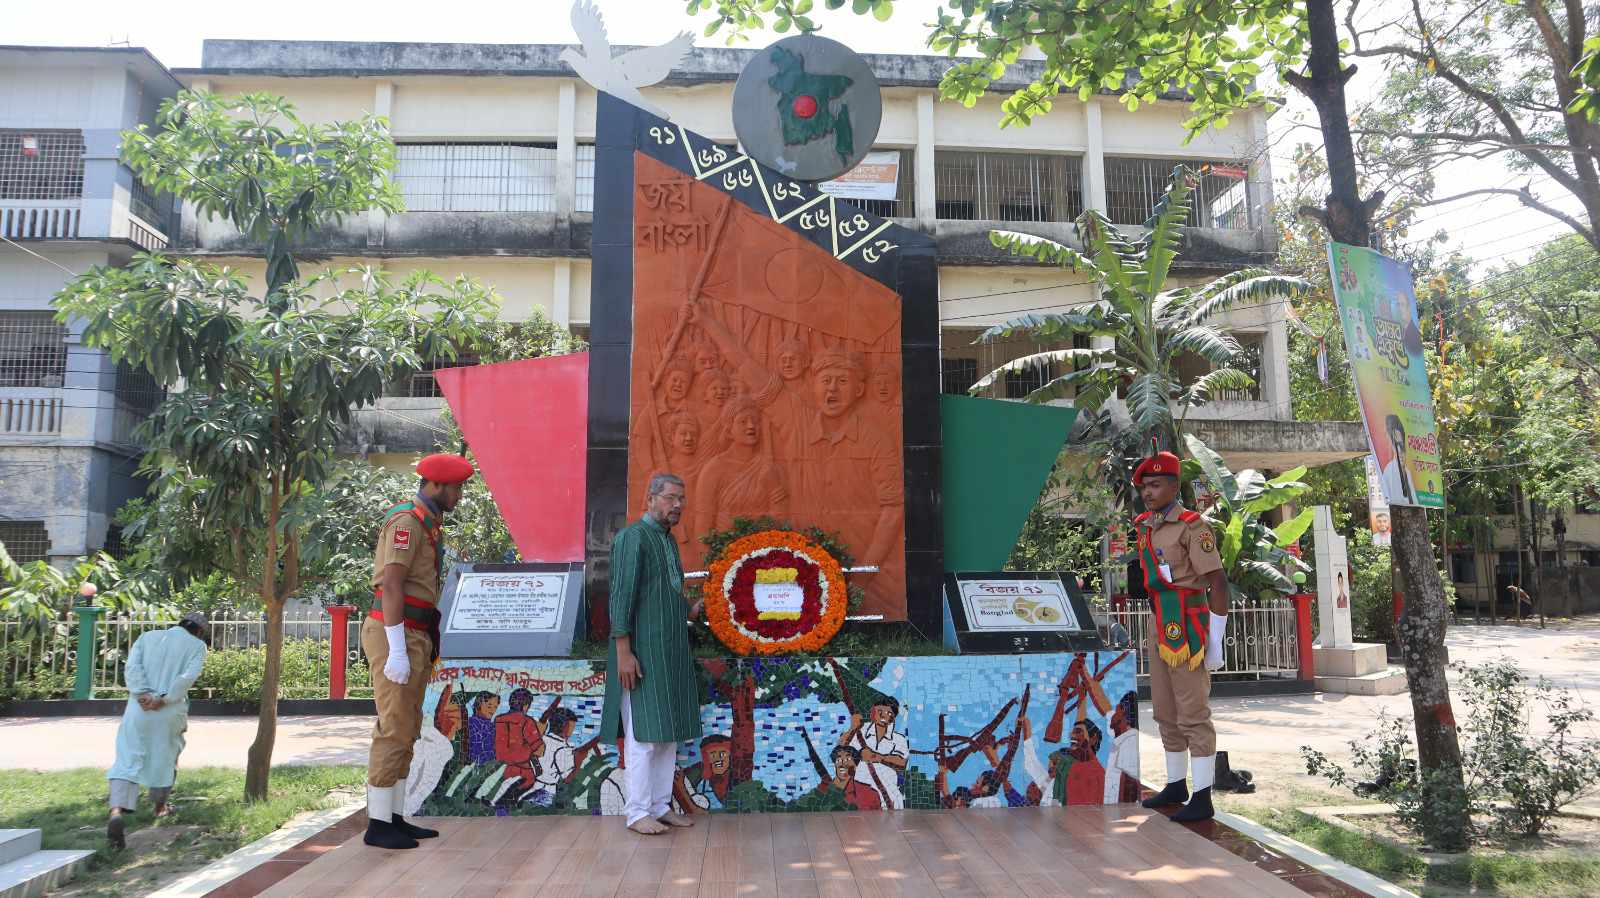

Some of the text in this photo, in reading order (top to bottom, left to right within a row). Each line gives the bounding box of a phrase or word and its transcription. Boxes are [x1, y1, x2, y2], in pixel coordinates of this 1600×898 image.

[649, 125, 676, 145] ৭১
[697, 145, 728, 168] ৬৯
[722, 168, 754, 191] ৬৬
[772, 182, 806, 201] ৬২
[799, 209, 830, 230] ৫৬
[838, 214, 870, 238] ৫৪
[637, 217, 711, 254] বাংলা
[862, 239, 899, 264] ৫২
[480, 578, 545, 588] বিজয় ৭১
[979, 583, 1044, 594] বিজয় ৭১
